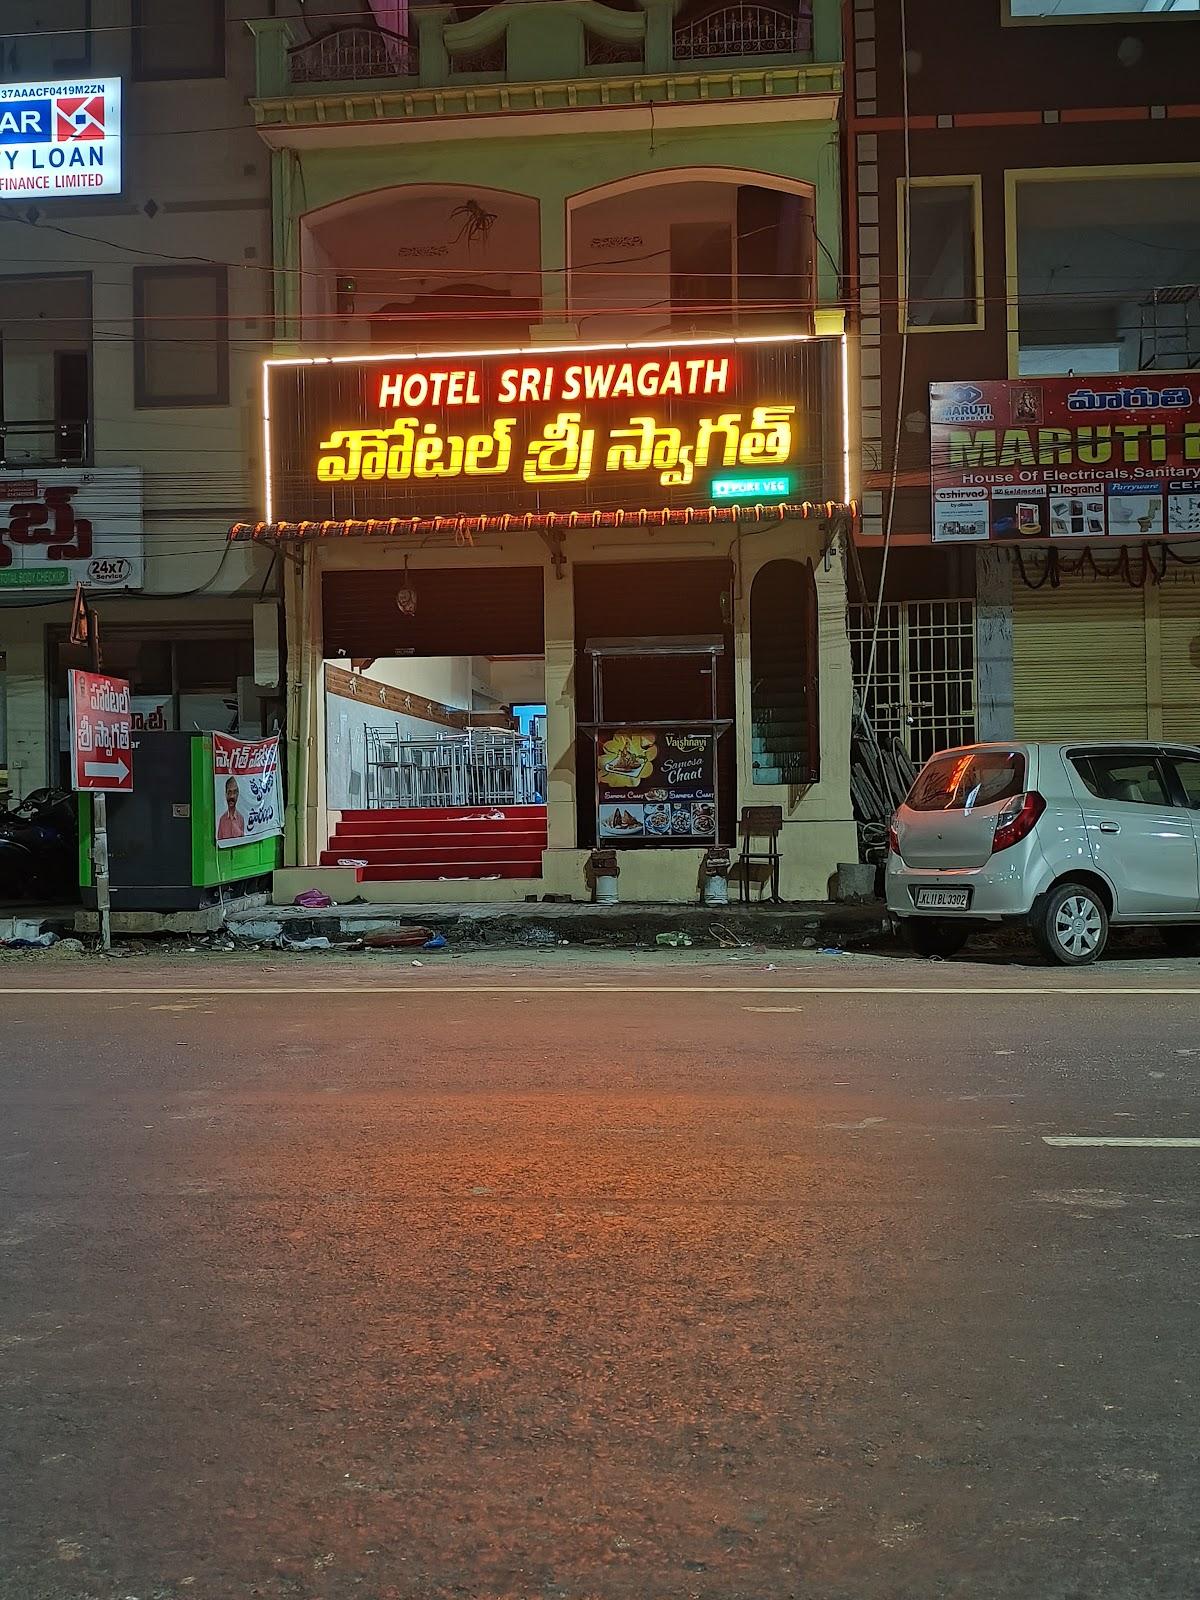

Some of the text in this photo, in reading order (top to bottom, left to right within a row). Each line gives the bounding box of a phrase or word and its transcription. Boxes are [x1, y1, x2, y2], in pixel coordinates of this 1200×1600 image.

[32, 146, 104, 169] LOAN
[0, 173, 104, 191] FINANCE LIMITED
[378, 358, 729, 408] HOTEL SRI SWAGATH
[316, 405, 796, 486] హోటల్ శ్రీ స్వాగత్
[950, 424, 1167, 468] MARUTI
[962, 473, 1014, 484] House
[1019, 470, 1039, 481] Of
[763, 480, 785, 492] VEG
[939, 489, 985, 499] ashirvad
[1060, 484, 1103, 496] legrand
[92, 560, 125, 575] 24x7
[665, 736, 707, 752] Vaishnavi
[660, 757, 704, 773] Samosa
[668, 768, 703, 784] Chaat
